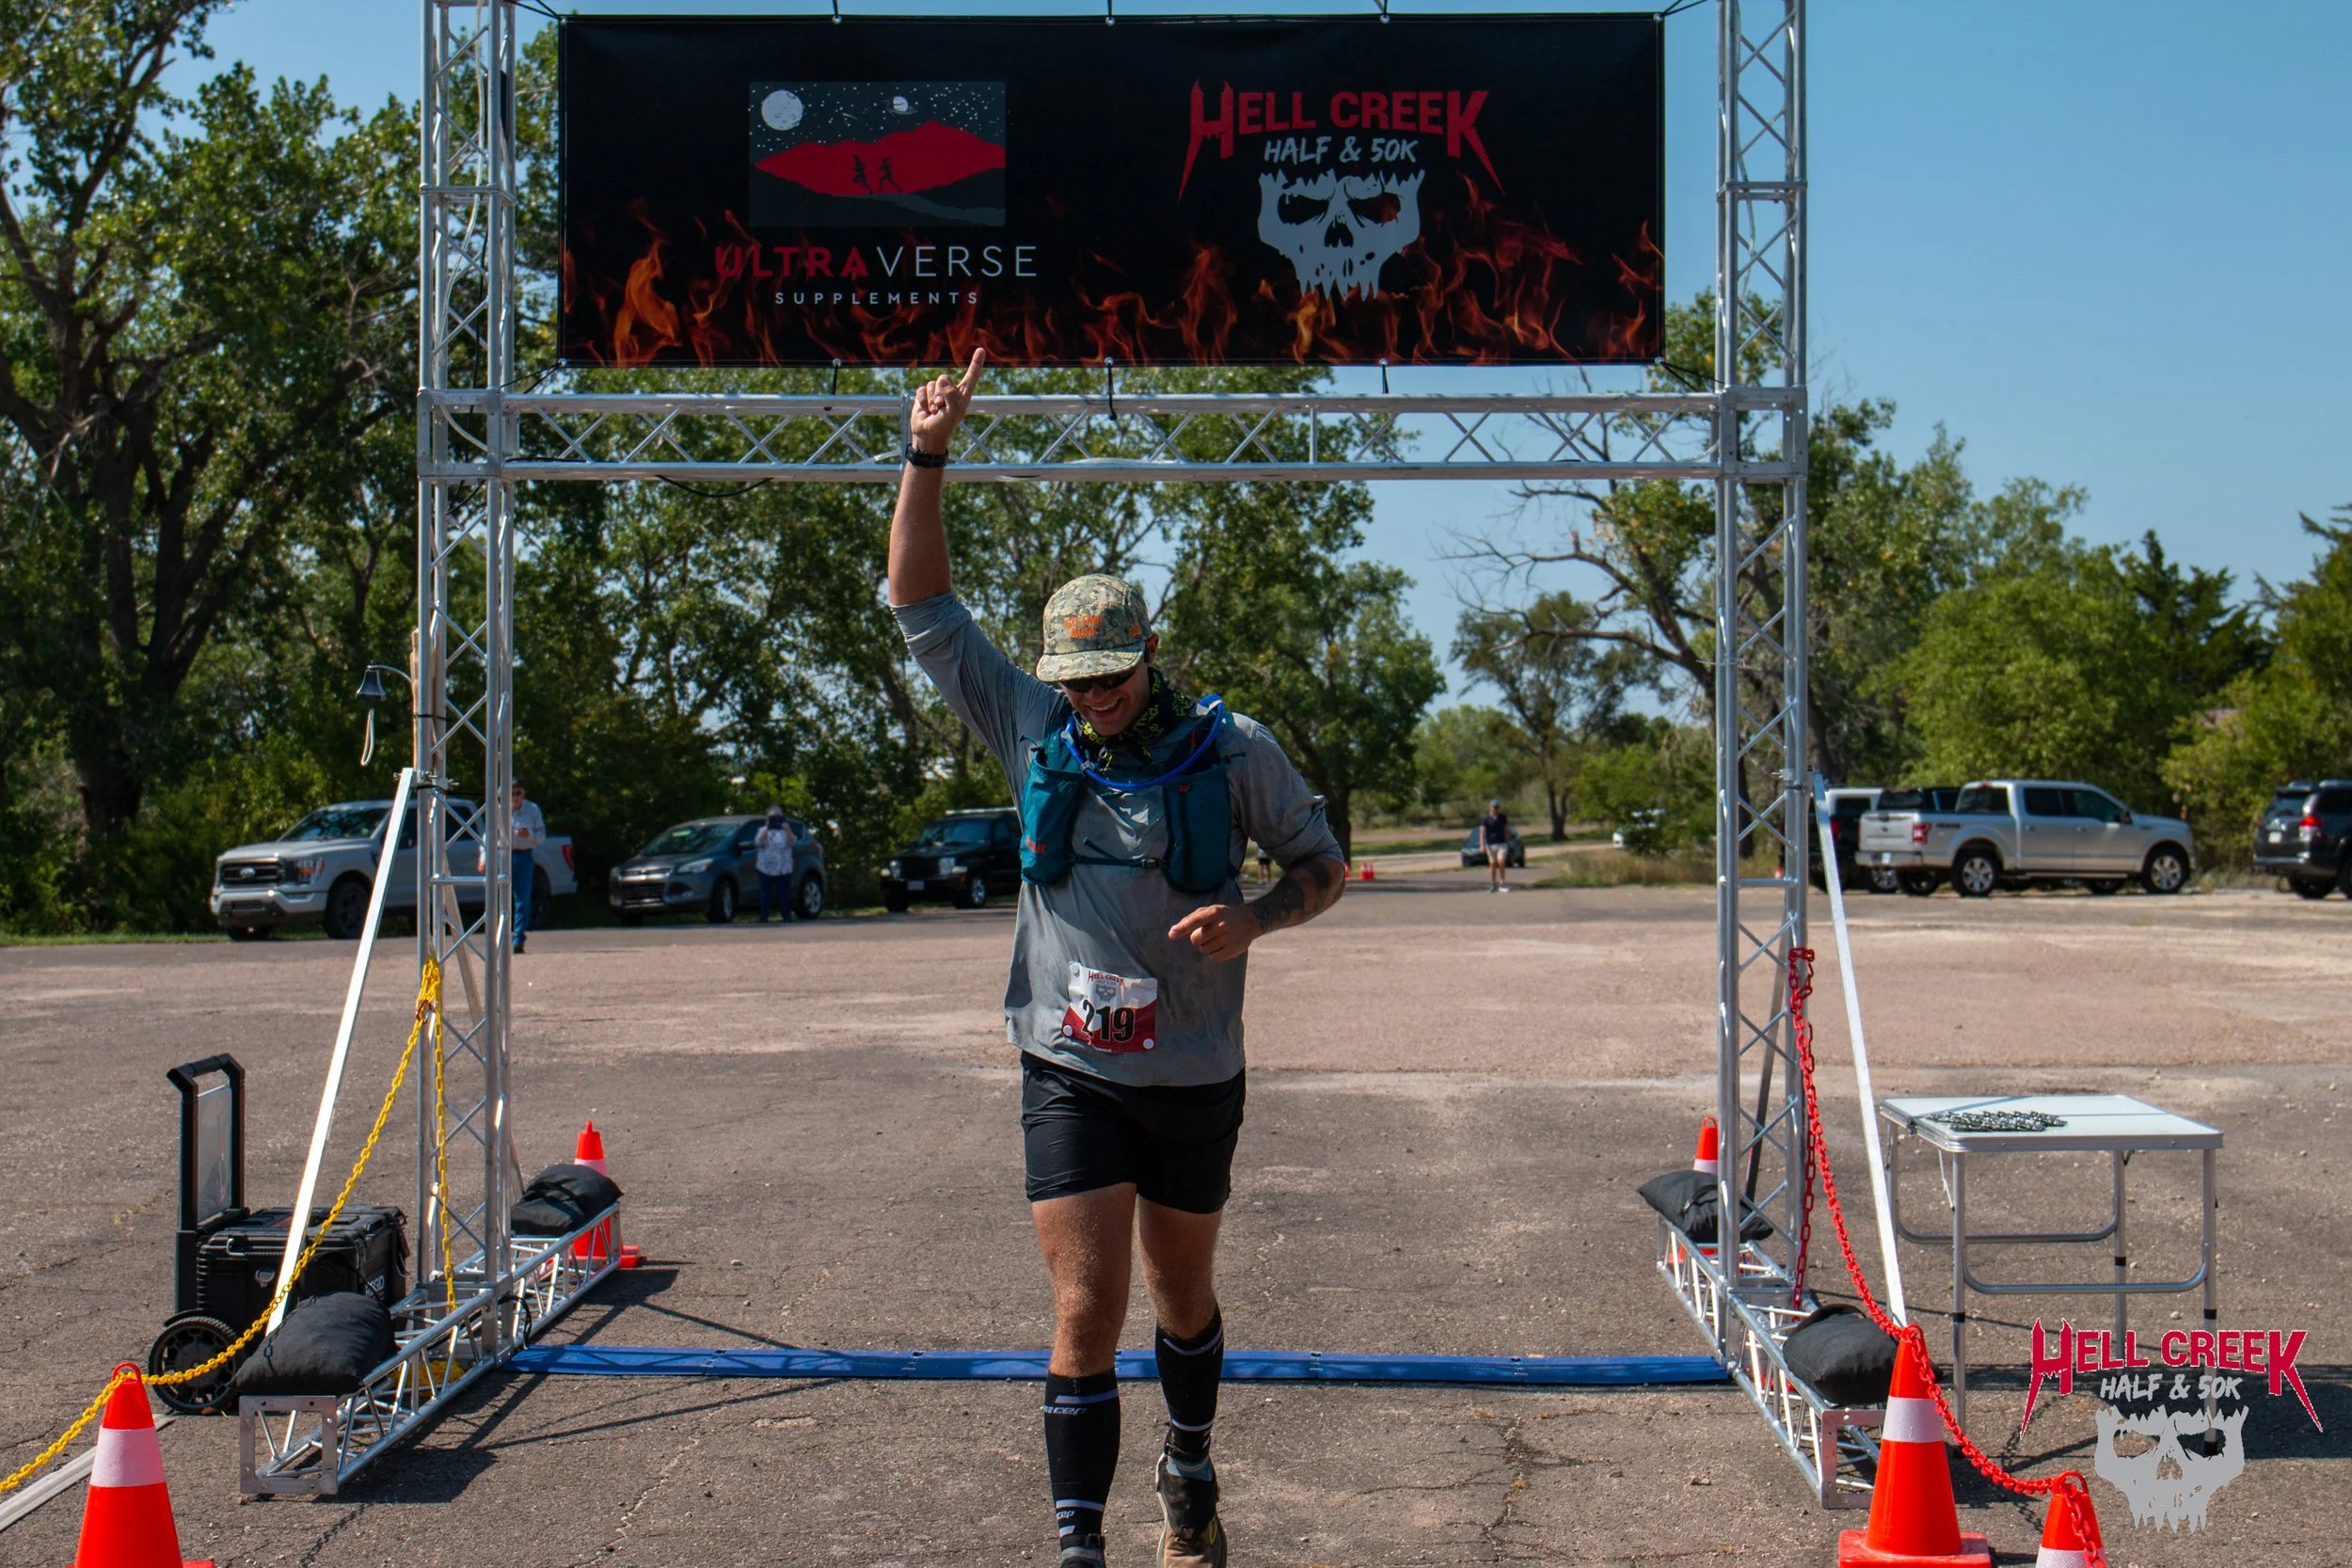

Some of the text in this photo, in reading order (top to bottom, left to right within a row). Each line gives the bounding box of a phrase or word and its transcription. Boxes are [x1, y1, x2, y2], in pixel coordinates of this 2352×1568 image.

[1178, 79, 1505, 203] HELL CREEK
[1263, 135, 1419, 164] HALF & 50K
[715, 245, 1038, 278] ULTRAVERSE
[774, 291, 979, 305] SUPPLEMENTS
[1082, 999, 1136, 1043] 219
